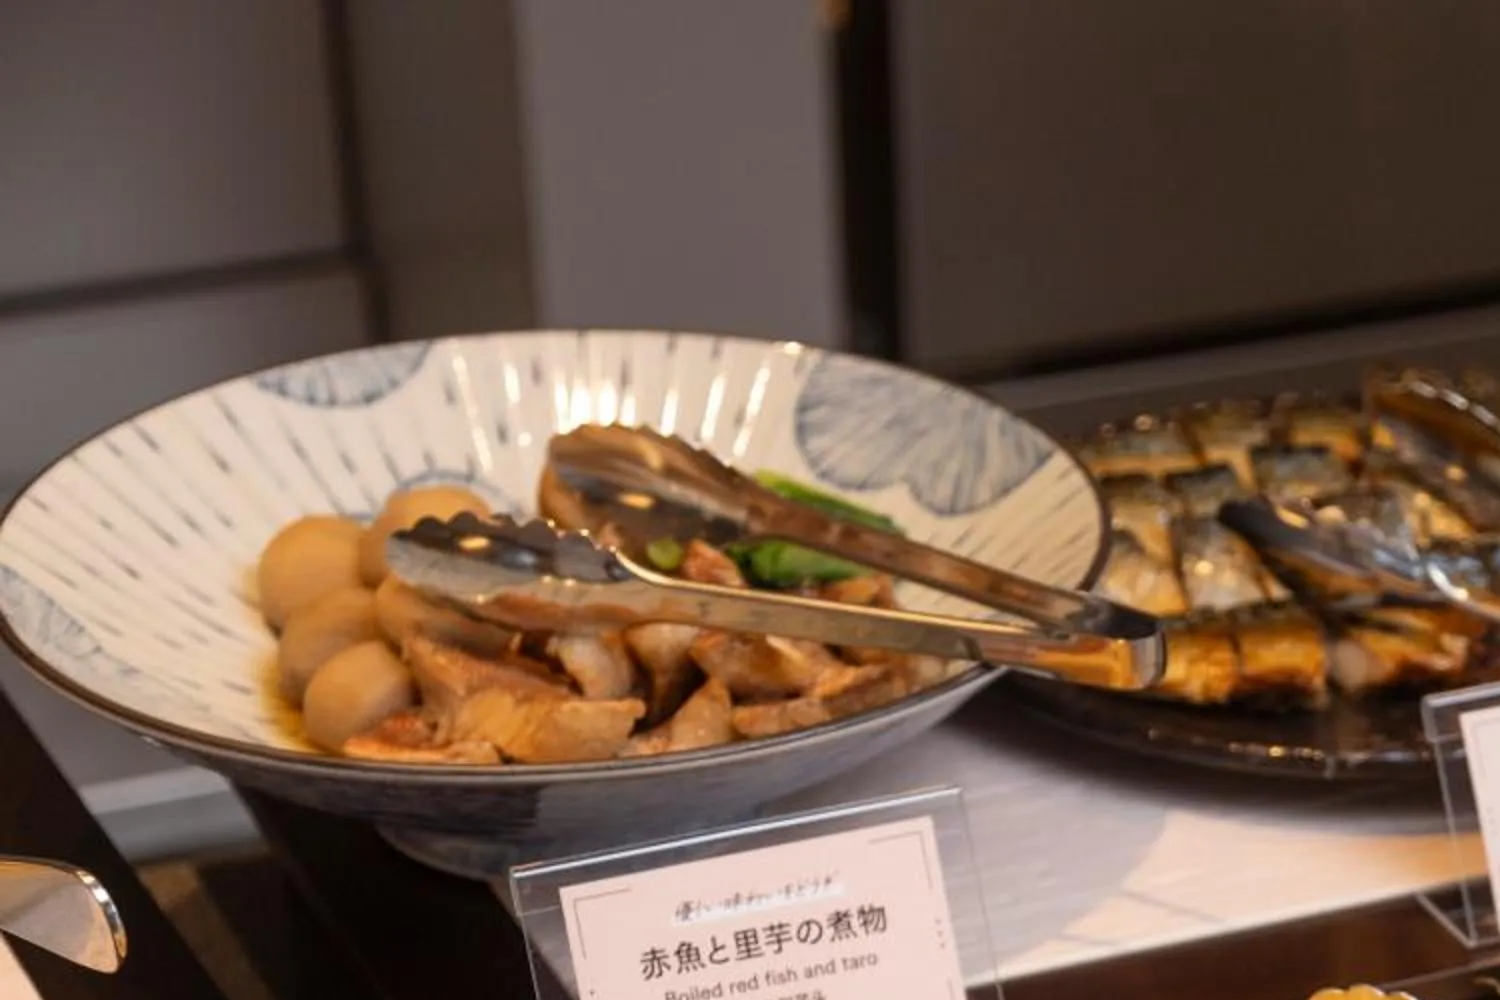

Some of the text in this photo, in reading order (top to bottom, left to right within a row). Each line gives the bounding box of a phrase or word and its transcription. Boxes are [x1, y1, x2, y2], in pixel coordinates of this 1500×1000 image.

[640, 903, 888, 981] 赤魚と里芋の煮物
[729, 974, 759, 995] red
[765, 967, 797, 987] fish
[804, 961, 836, 980] and
[842, 953, 878, 973] taro
